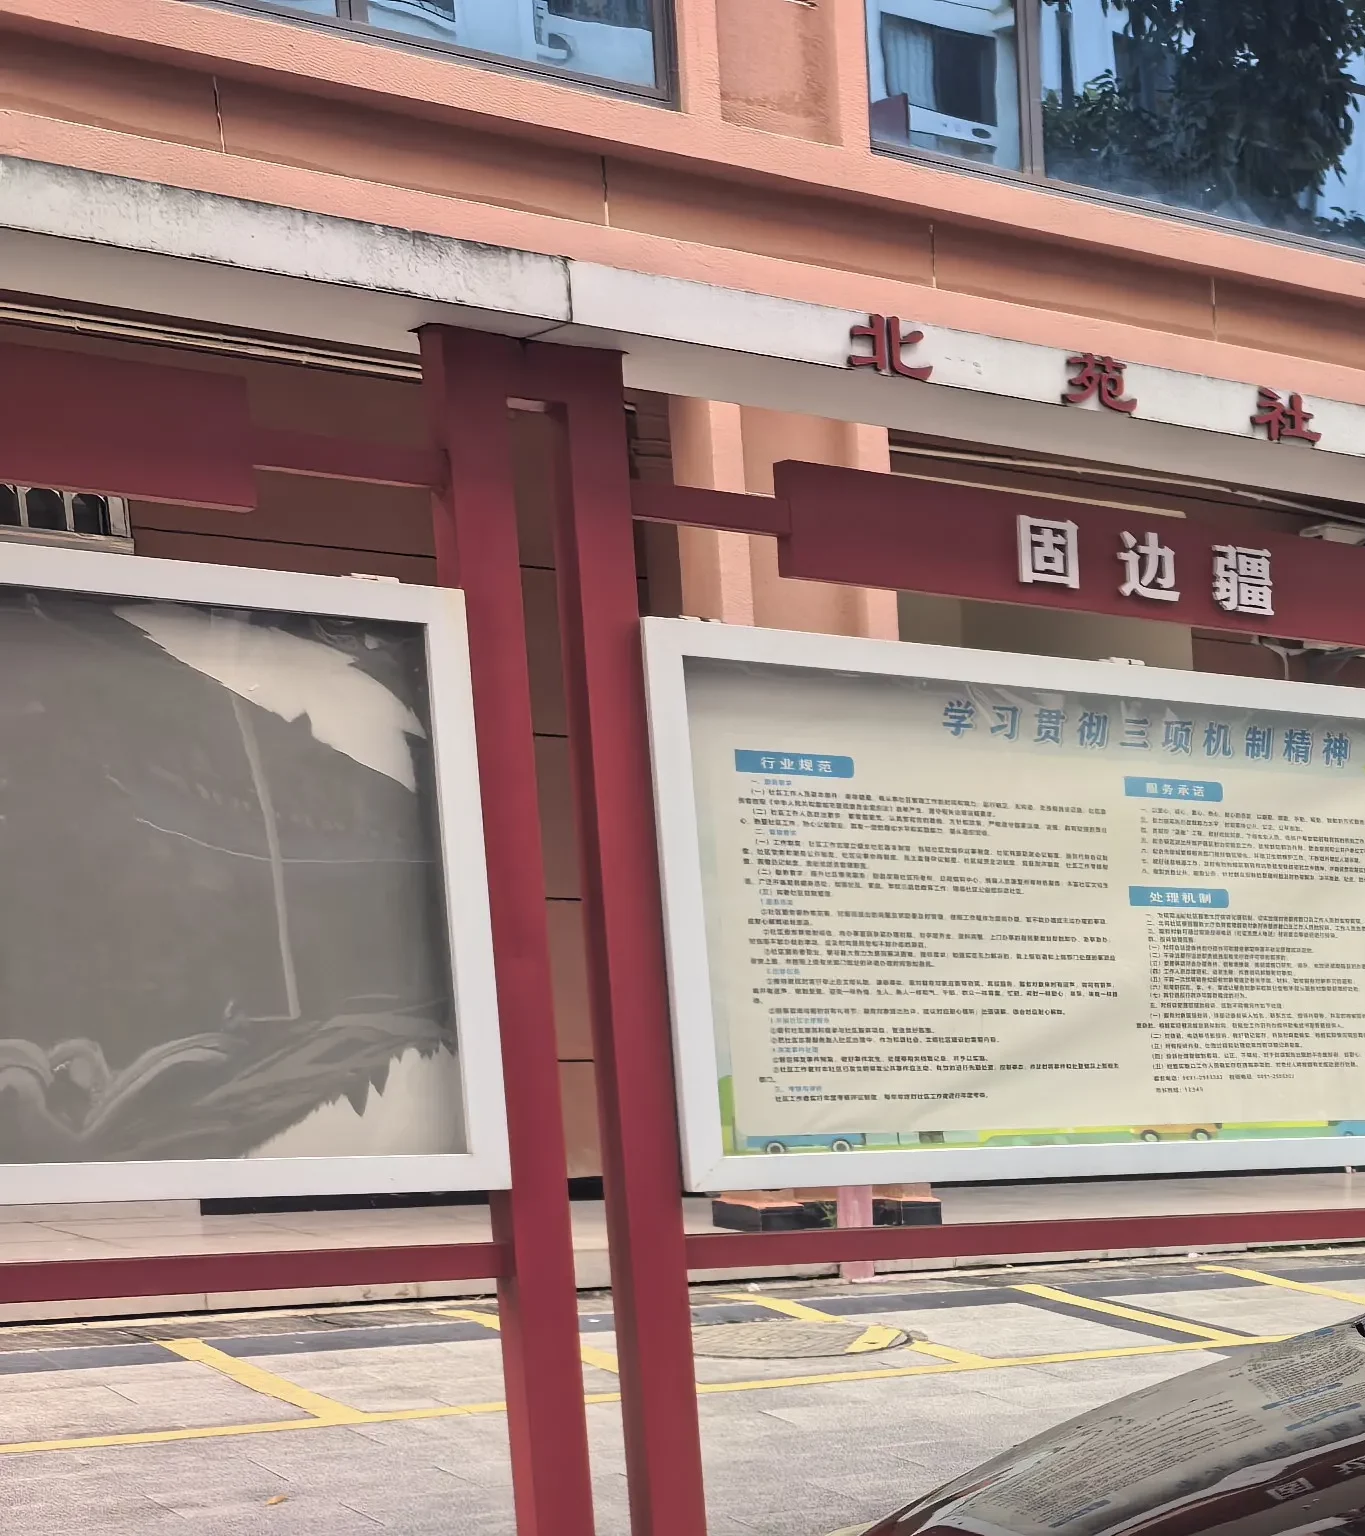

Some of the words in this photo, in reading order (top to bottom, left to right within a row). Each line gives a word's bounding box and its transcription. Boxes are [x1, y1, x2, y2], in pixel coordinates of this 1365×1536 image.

[1016, 513, 1276, 616] 固边疆
[760, 755, 833, 774] 行业规范
[941, 700, 1351, 768] 学习贯彻三项机制精神
